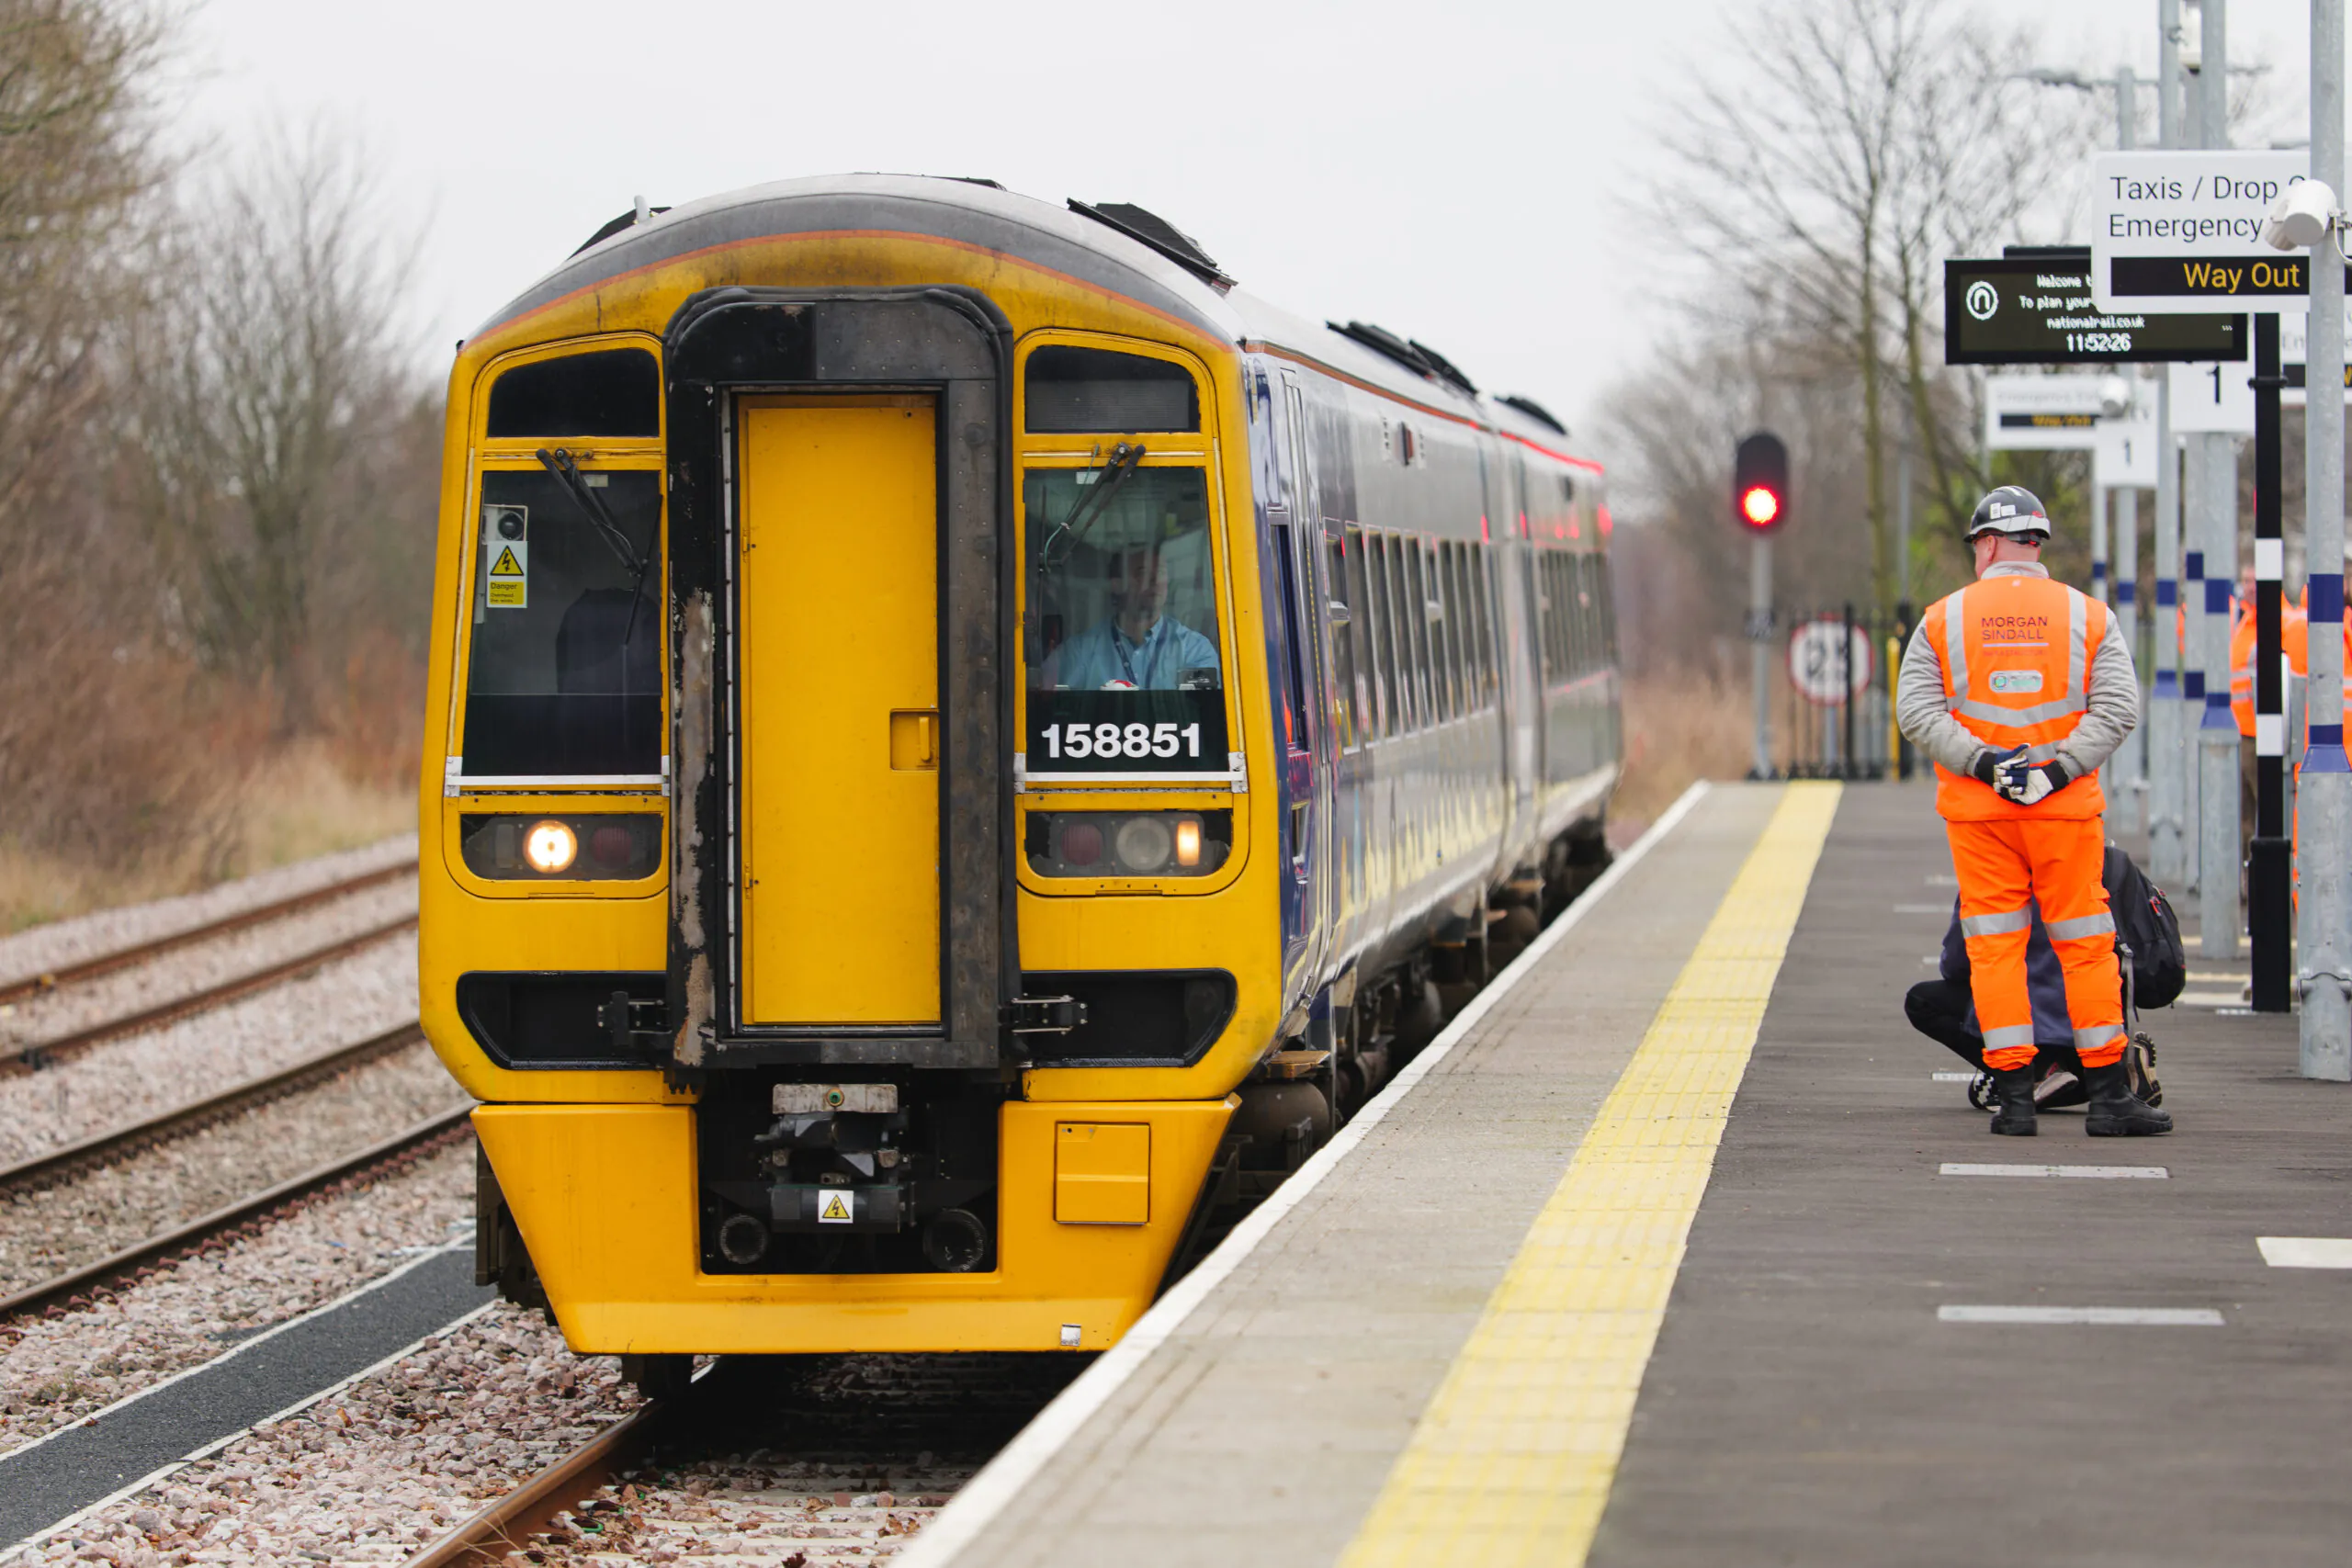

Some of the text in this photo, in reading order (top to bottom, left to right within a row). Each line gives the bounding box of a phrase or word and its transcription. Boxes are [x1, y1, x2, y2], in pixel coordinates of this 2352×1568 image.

[2109, 175, 2182, 200] Taxis
[2213, 175, 2278, 205] Drop
[2109, 214, 2263, 243] Emergency
[2037, 274, 2082, 288] Welcome
[2183, 263, 2301, 294] Way Out
[2018, 295, 2093, 312] To plan your
[2046, 315, 2145, 330] nationalrail.co.uk
[2205, 365, 2221, 405] 1
[1981, 616, 2048, 627] MORGAN
[1982, 629, 2044, 640] SINDALL
[1041, 723, 1200, 759] 158851
